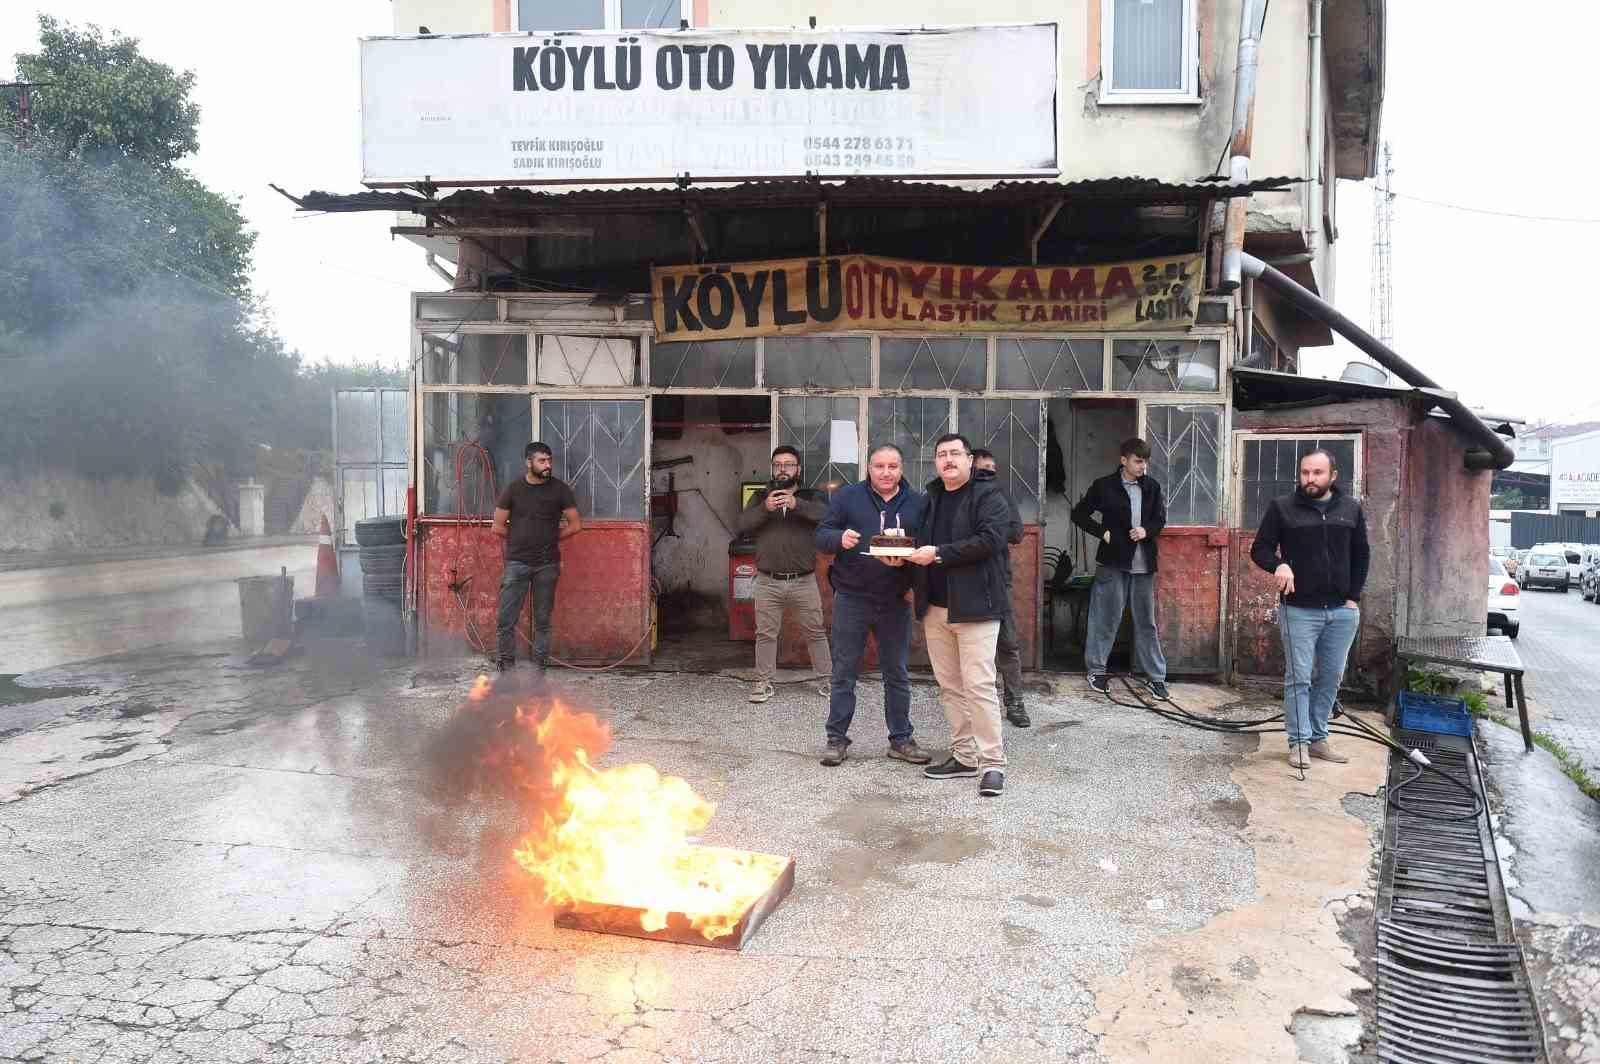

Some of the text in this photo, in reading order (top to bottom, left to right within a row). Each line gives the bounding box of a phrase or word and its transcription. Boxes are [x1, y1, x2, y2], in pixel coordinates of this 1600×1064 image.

[512, 36, 911, 91] KÖYLÜ OTO YIKAMA
[511, 137, 604, 154] TEVFİK KIRIŞOĞLU
[804, 137, 840, 150] 0544
[843, 137, 872, 150] 278
[875, 137, 893, 150] 63
[513, 157, 544, 168] SADIK
[662, 260, 1138, 333] KÖYLÜ OTO YIKAMA
[902, 298, 1108, 323] LASTİK TAMİRİ
